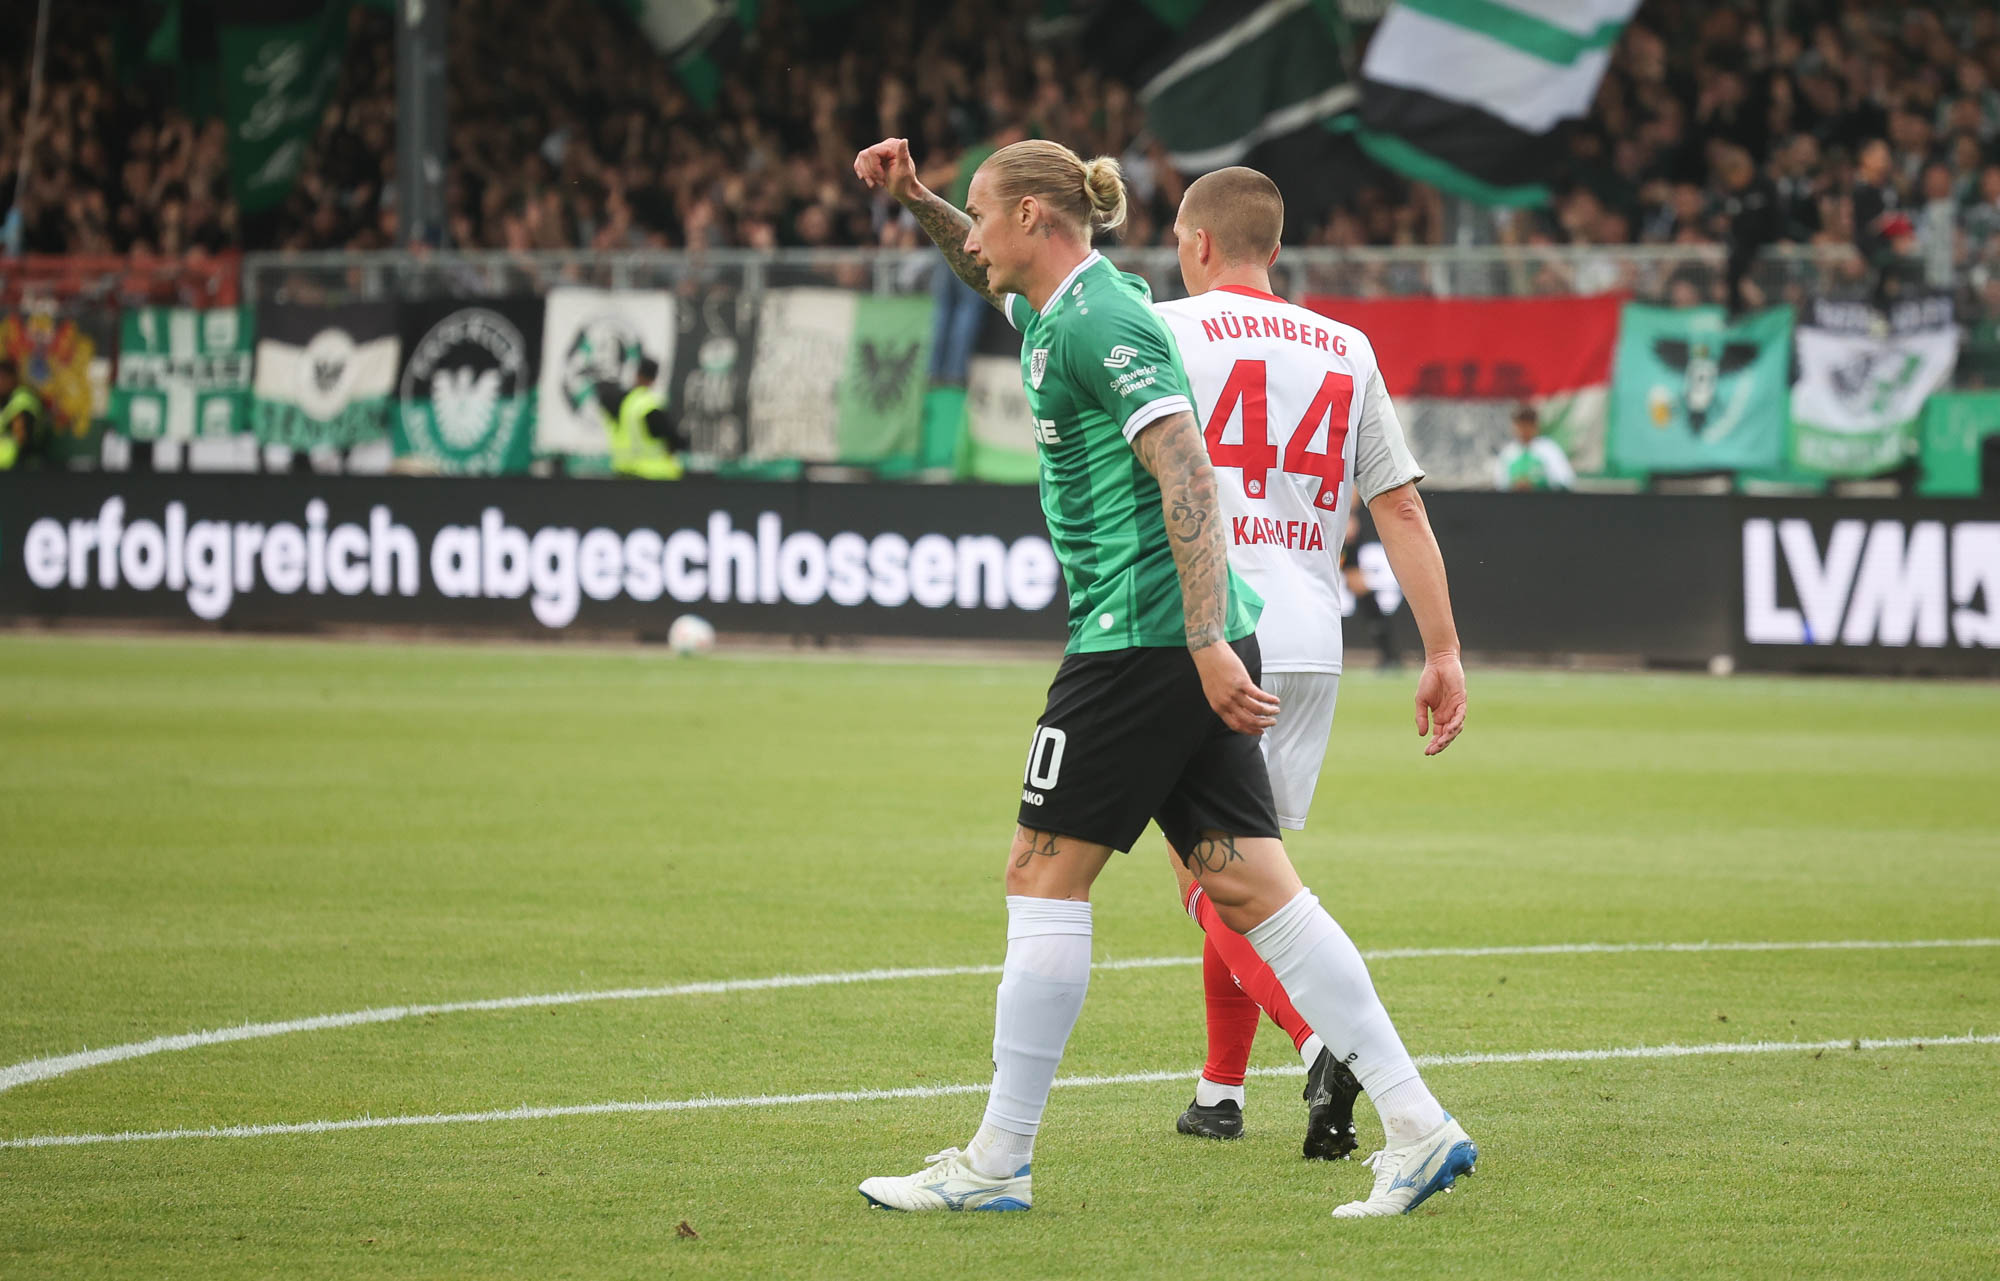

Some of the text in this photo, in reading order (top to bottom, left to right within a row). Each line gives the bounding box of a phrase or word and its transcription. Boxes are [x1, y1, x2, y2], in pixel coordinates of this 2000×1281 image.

[1201, 311, 1347, 357] NÜRNBERG
[1109, 365, 1158, 392] Stadtwerke
[1119, 376, 1157, 399] Münster
[1203, 359, 1354, 512] 44
[1232, 515, 1328, 551] KARAFIA
[22, 496, 1059, 628] erfolgreich abgeschlossene
